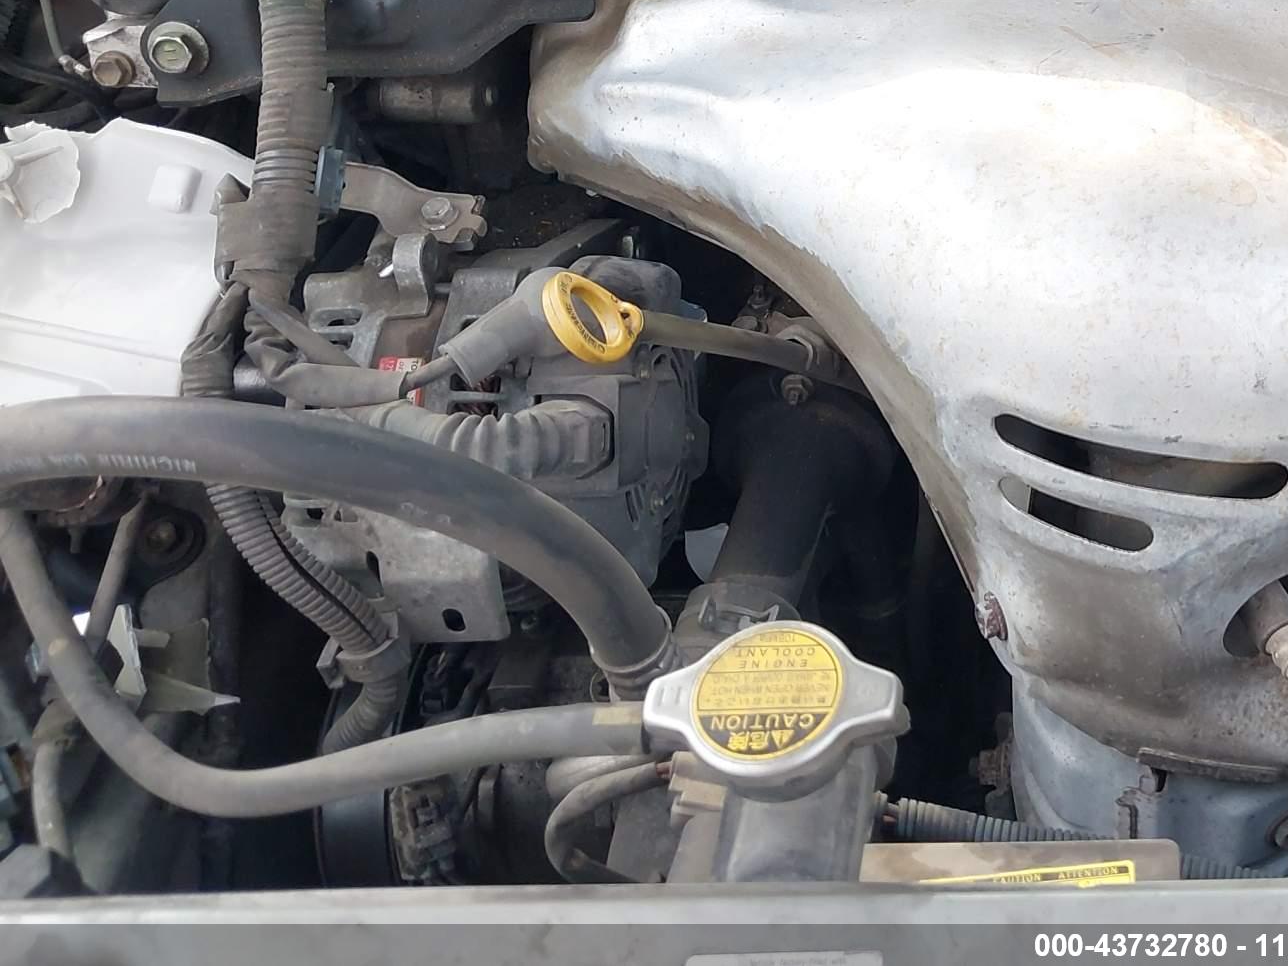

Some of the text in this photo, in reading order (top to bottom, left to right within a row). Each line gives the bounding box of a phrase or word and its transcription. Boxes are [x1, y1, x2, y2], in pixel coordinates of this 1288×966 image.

[735, 646, 816, 658] COOLANT
[739, 659, 808, 669] ENGINE
[711, 713, 815, 730] CAUTION
[1057, 865, 1120, 880] ATTENTION
